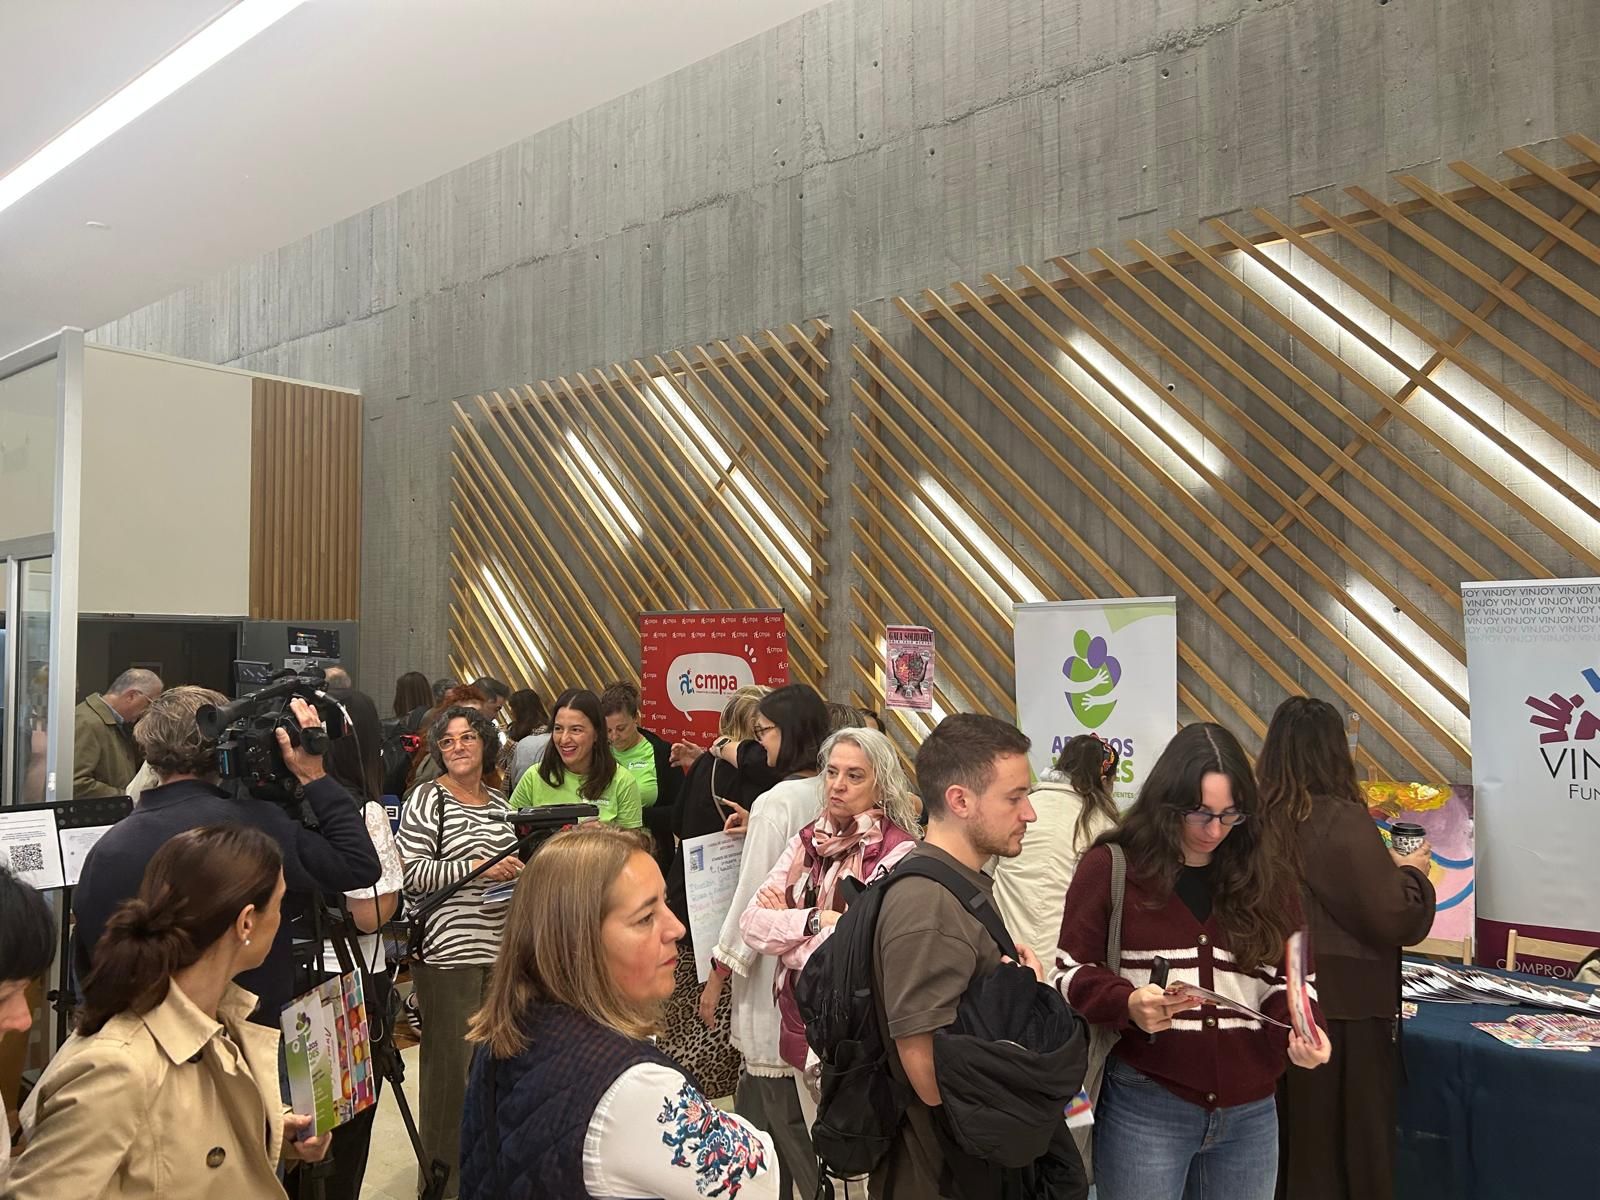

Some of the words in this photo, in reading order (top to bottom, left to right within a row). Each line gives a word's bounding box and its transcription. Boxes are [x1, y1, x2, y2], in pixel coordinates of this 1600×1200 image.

[1557, 586, 1594, 594] VINJOY
[1466, 599, 1499, 607] VINJOY
[1501, 598, 1536, 606] VINJOY
[1538, 597, 1574, 605] VINJOY
[1501, 616, 1536, 624] VINJOY
[695, 674, 737, 695] cmpa
[1540, 748, 1600, 780] VIN
